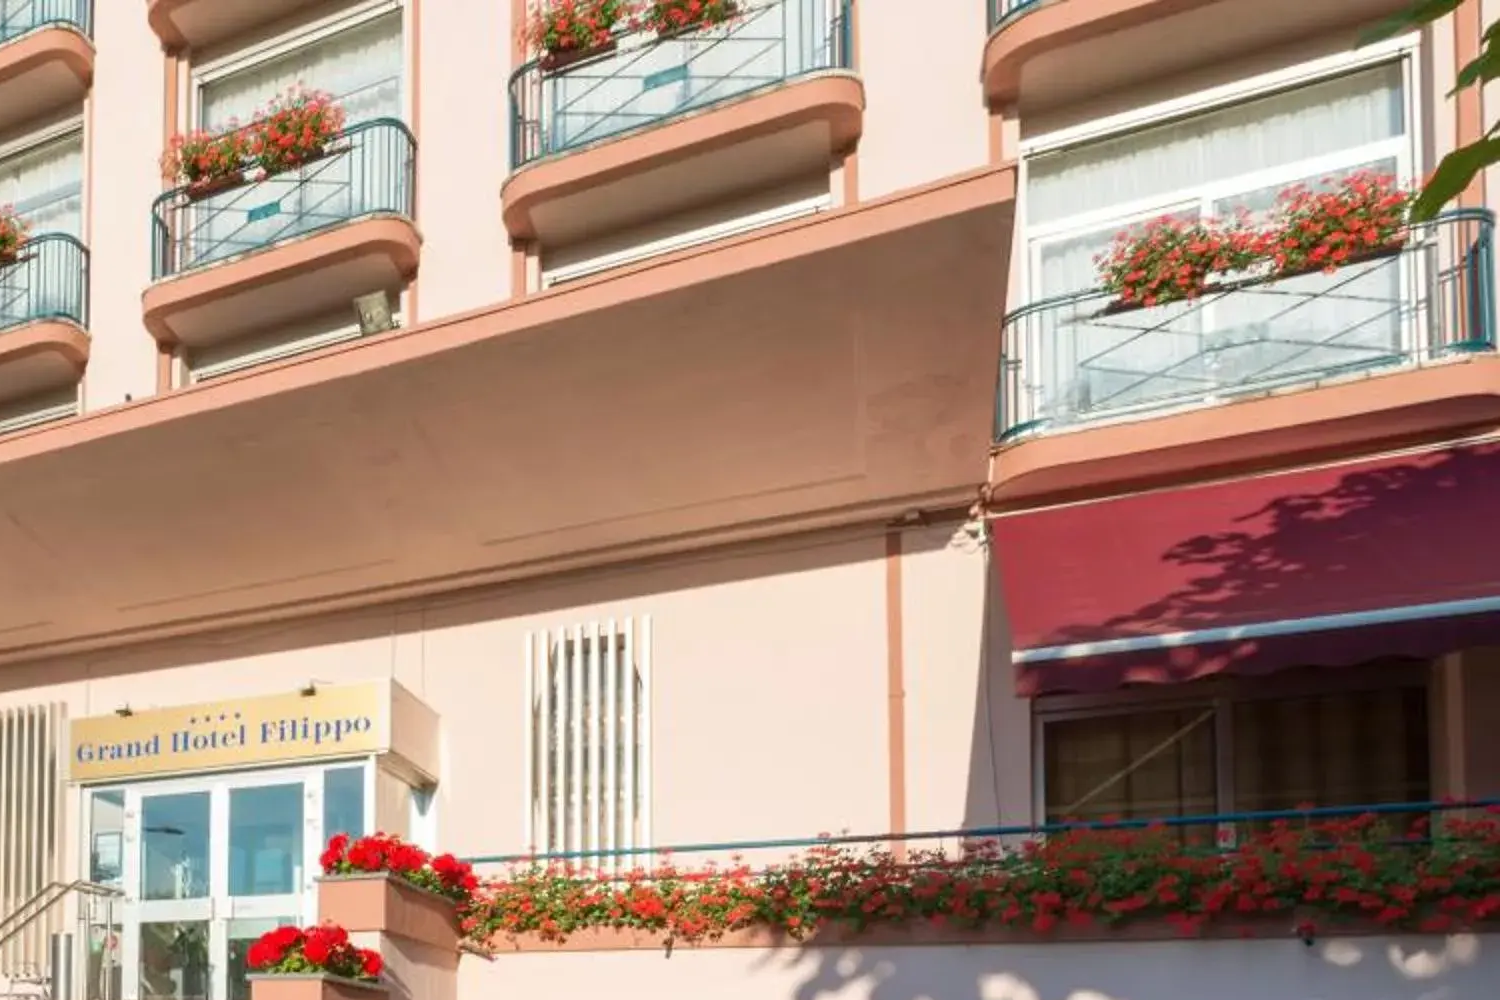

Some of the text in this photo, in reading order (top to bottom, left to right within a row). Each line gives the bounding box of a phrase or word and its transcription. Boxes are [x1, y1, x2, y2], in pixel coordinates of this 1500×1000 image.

[76, 715, 372, 764] Grand Hotel Filippo
